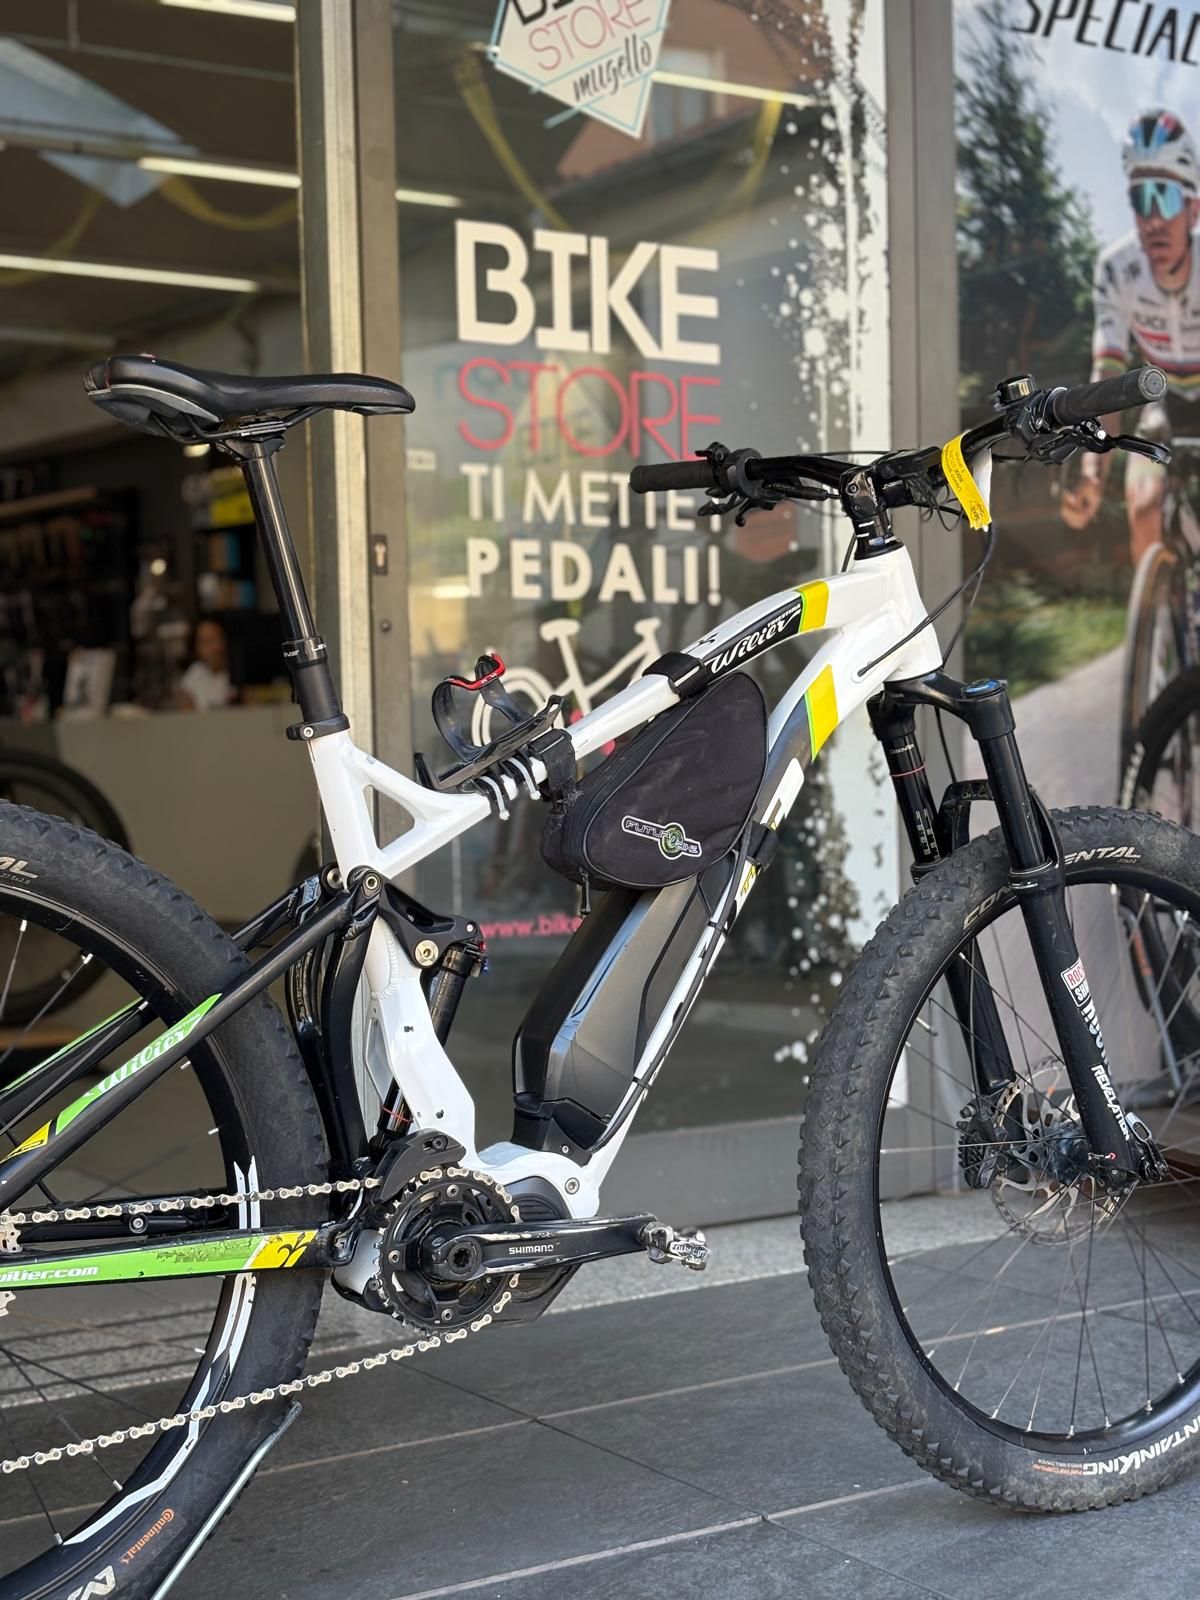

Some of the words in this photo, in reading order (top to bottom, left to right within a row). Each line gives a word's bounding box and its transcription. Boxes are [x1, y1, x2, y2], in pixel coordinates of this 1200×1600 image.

[529, 0, 651, 71] STORE
[573, 33, 651, 102] mugello
[456, 219, 720, 365] BIKE
[458, 358, 721, 461] STORE
[460, 463, 504, 522] TI
[467, 538, 721, 606] PEDALI!
[704, 609, 801, 674] Wilier
[1091, 1064, 1130, 1142] REVELATION
[509, 1244, 554, 1255] SHIMANO
[1083, 1414, 1200, 1476] NTAINKING
[124, 1508, 175, 1561] Continental
